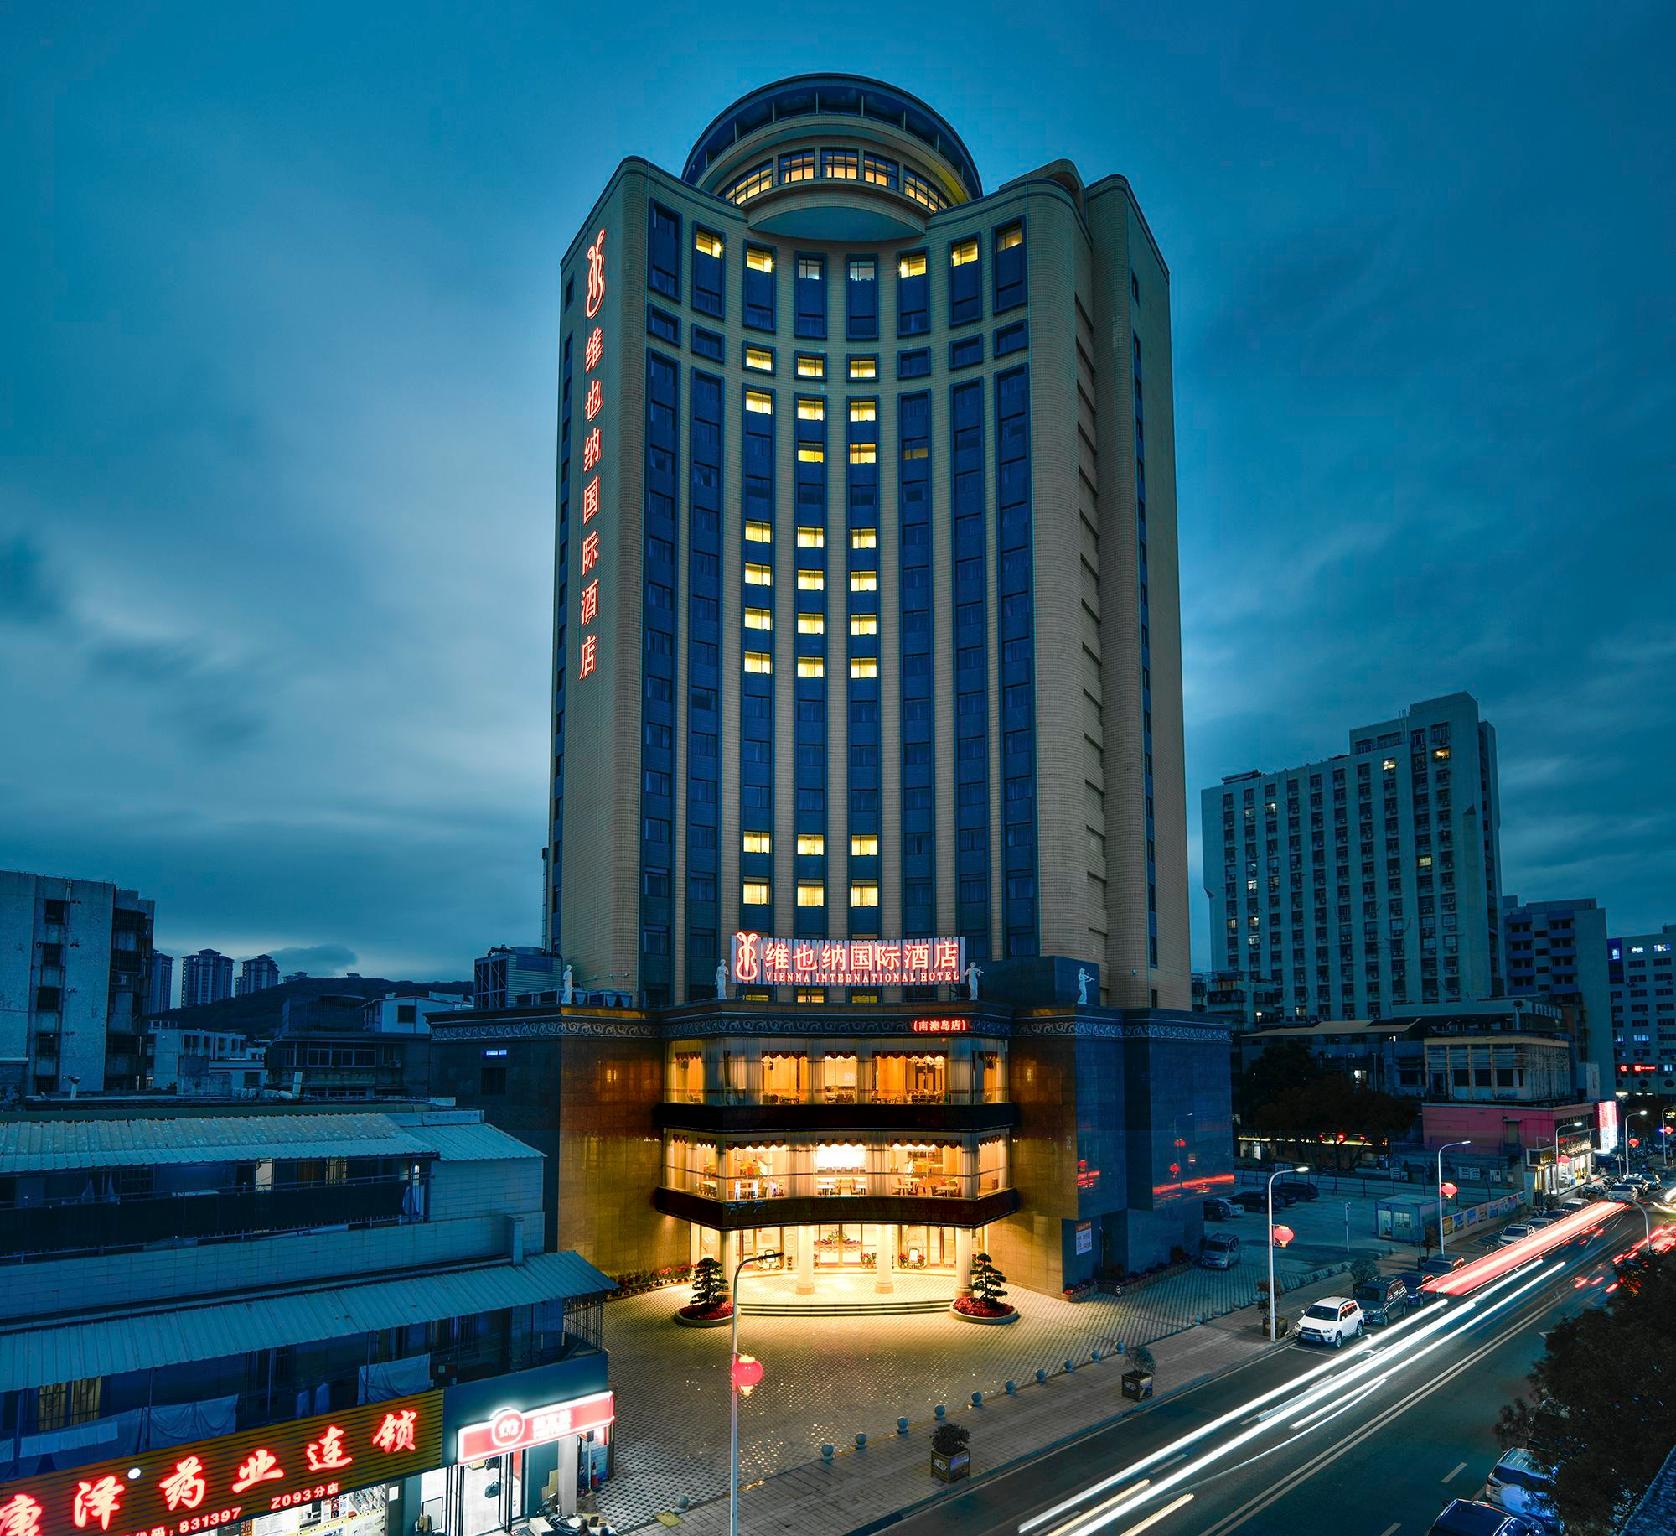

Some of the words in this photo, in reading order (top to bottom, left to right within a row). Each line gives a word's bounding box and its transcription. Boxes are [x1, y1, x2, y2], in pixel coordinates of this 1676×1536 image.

[578, 327, 603, 681] 维也纳国际酒店
[765, 941, 959, 972] 维也纳国际酒店
[766, 972, 811, 983] VIENNA
[815, 972, 916, 983] INTERNATIONAL
[920, 971, 960, 982] HOTEL
